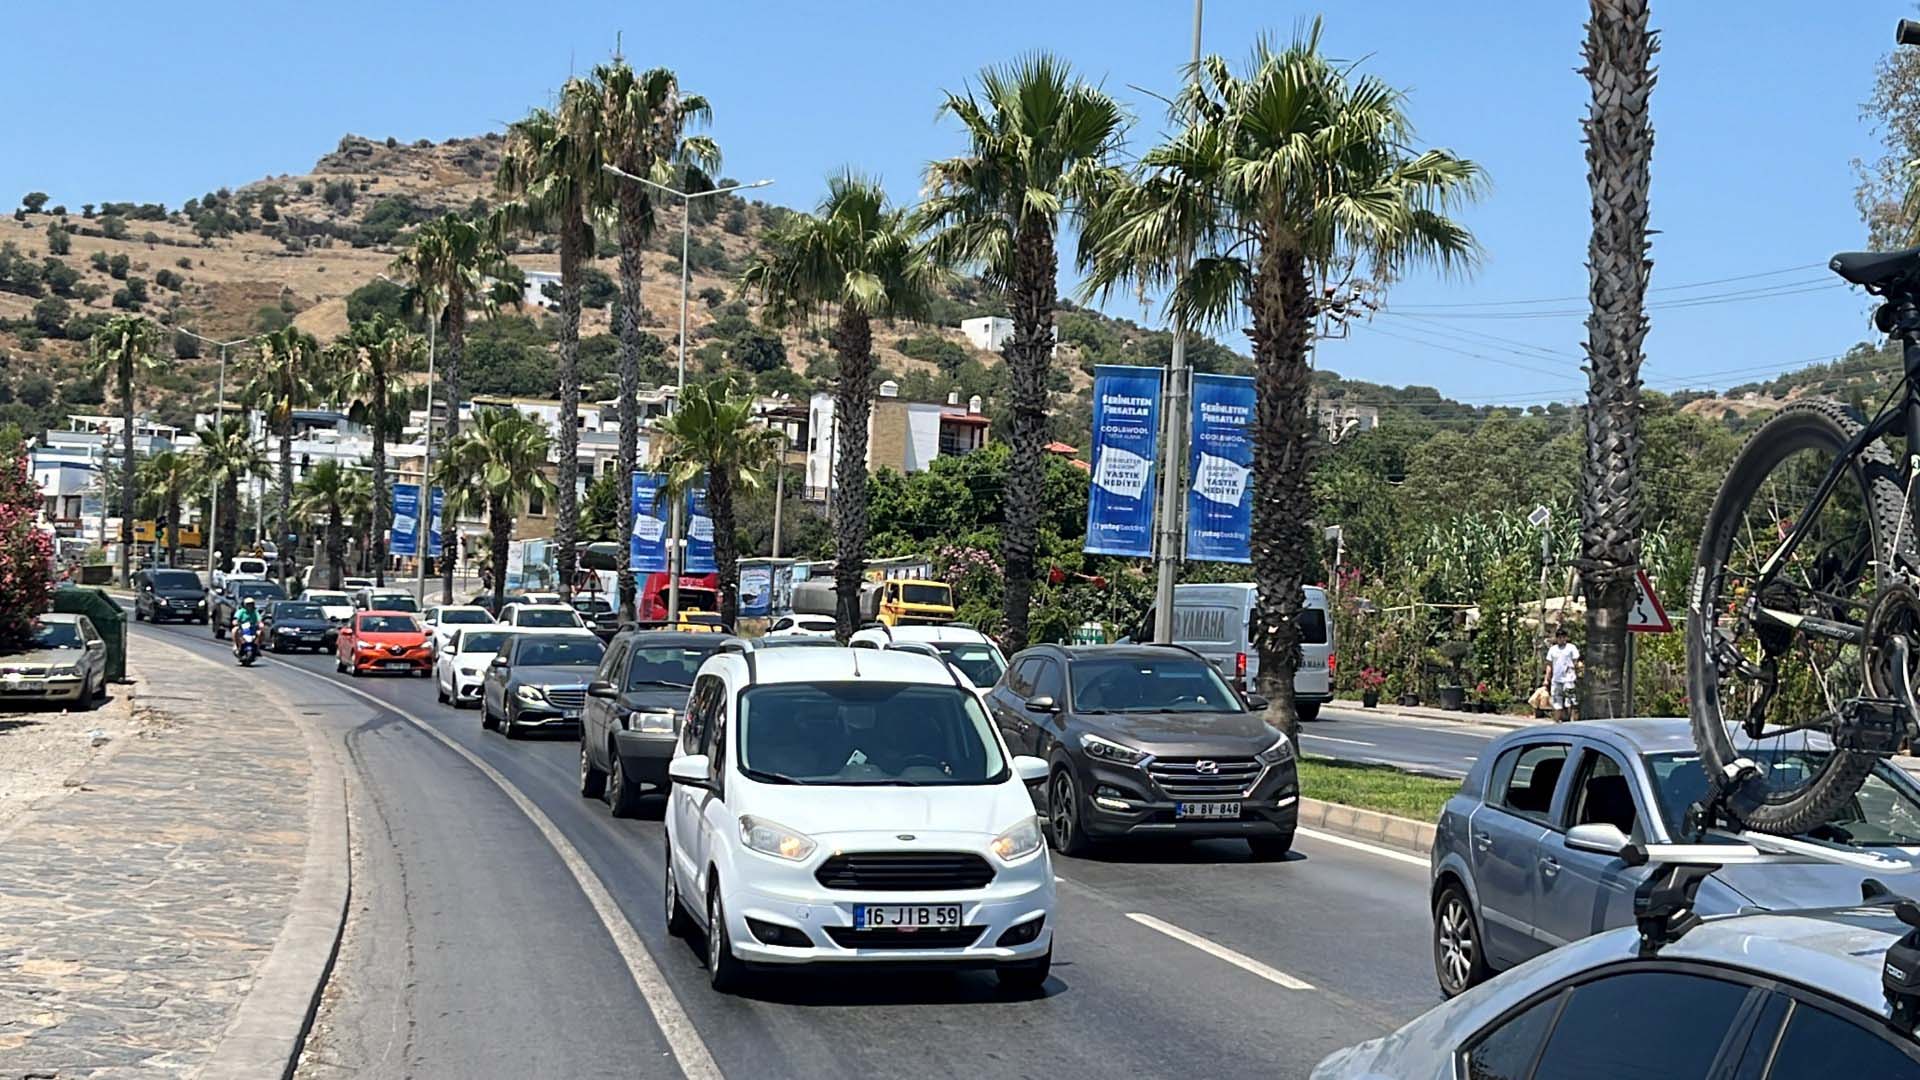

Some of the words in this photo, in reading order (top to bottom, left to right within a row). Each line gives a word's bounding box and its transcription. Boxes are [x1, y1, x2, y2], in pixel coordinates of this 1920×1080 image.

[1183, 609, 1226, 641] YAMAHA
[1200, 804, 1214, 815] BV
[866, 907, 884, 926] 16
[891, 907, 930, 926] JIB
[936, 907, 958, 926] 59
